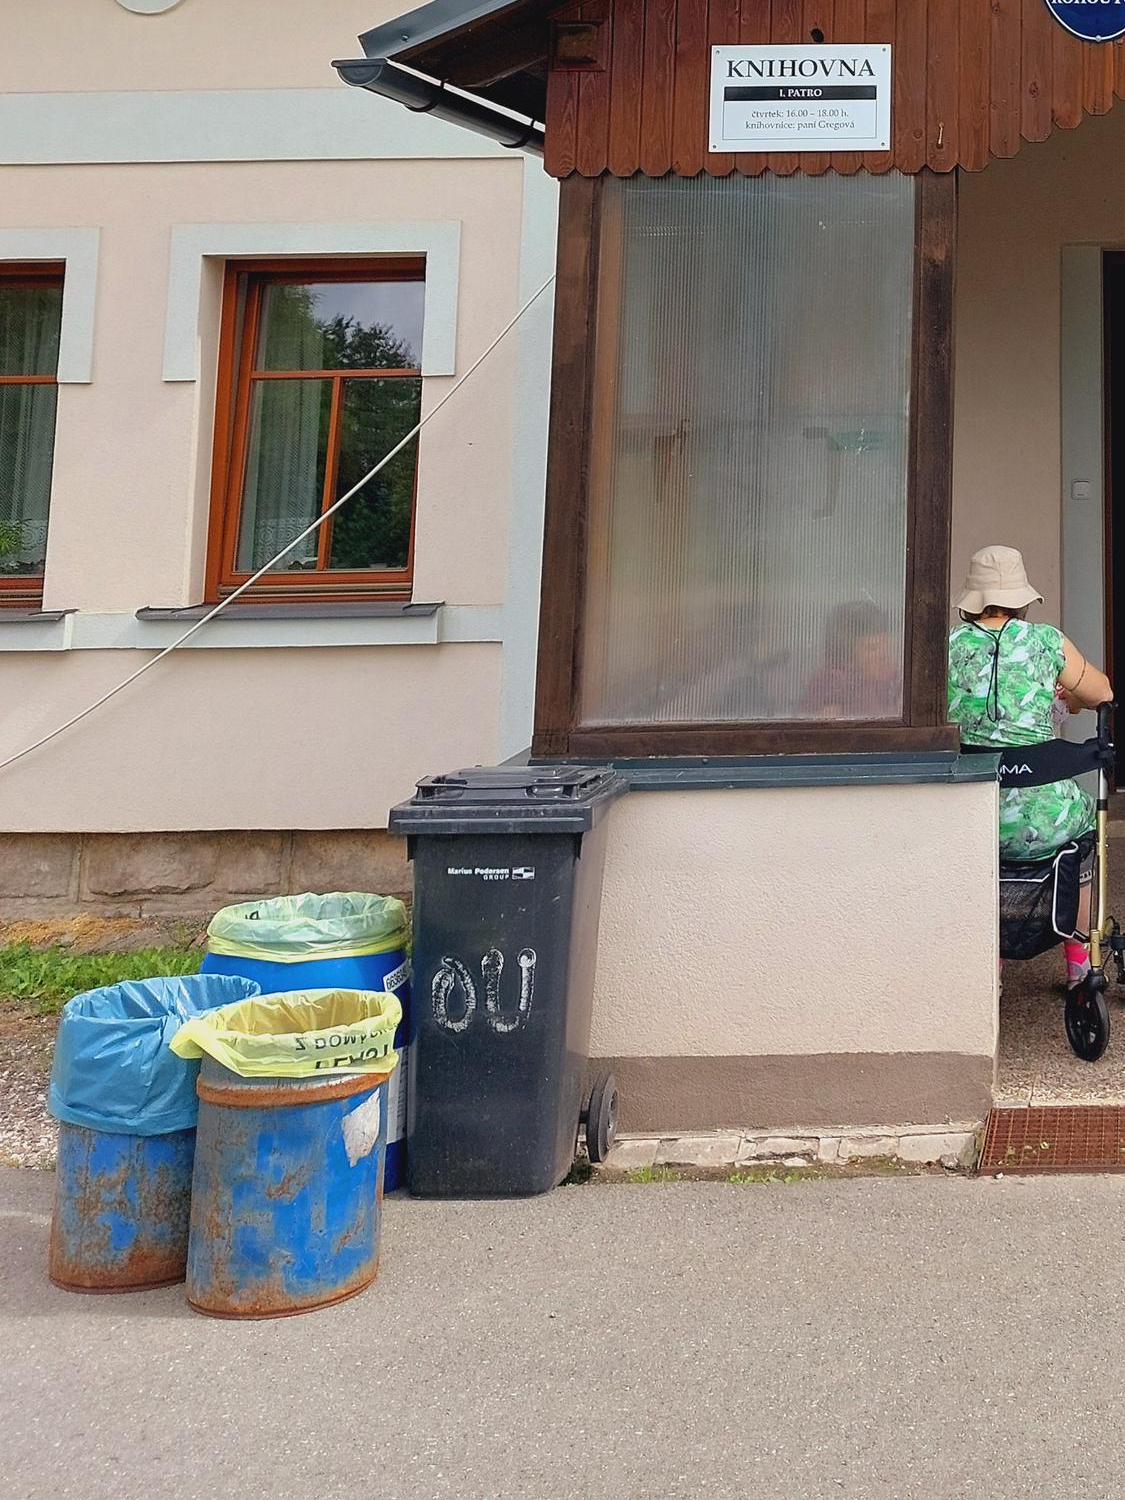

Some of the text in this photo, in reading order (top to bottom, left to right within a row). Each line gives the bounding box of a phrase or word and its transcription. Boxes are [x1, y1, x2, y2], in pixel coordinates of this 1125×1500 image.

[726, 59, 876, 78] KNIHOVNA
[787, 88, 823, 98] PATRO
[751, 109, 784, 119] čtvrtek:
[786, 109, 809, 118] 16.00
[817, 109, 840, 118] 18.00
[841, 109, 849, 118] h.
[745, 120, 796, 130] knihovnice:
[797, 120, 817, 132] paní
[447, 867, 473, 875] Marius
